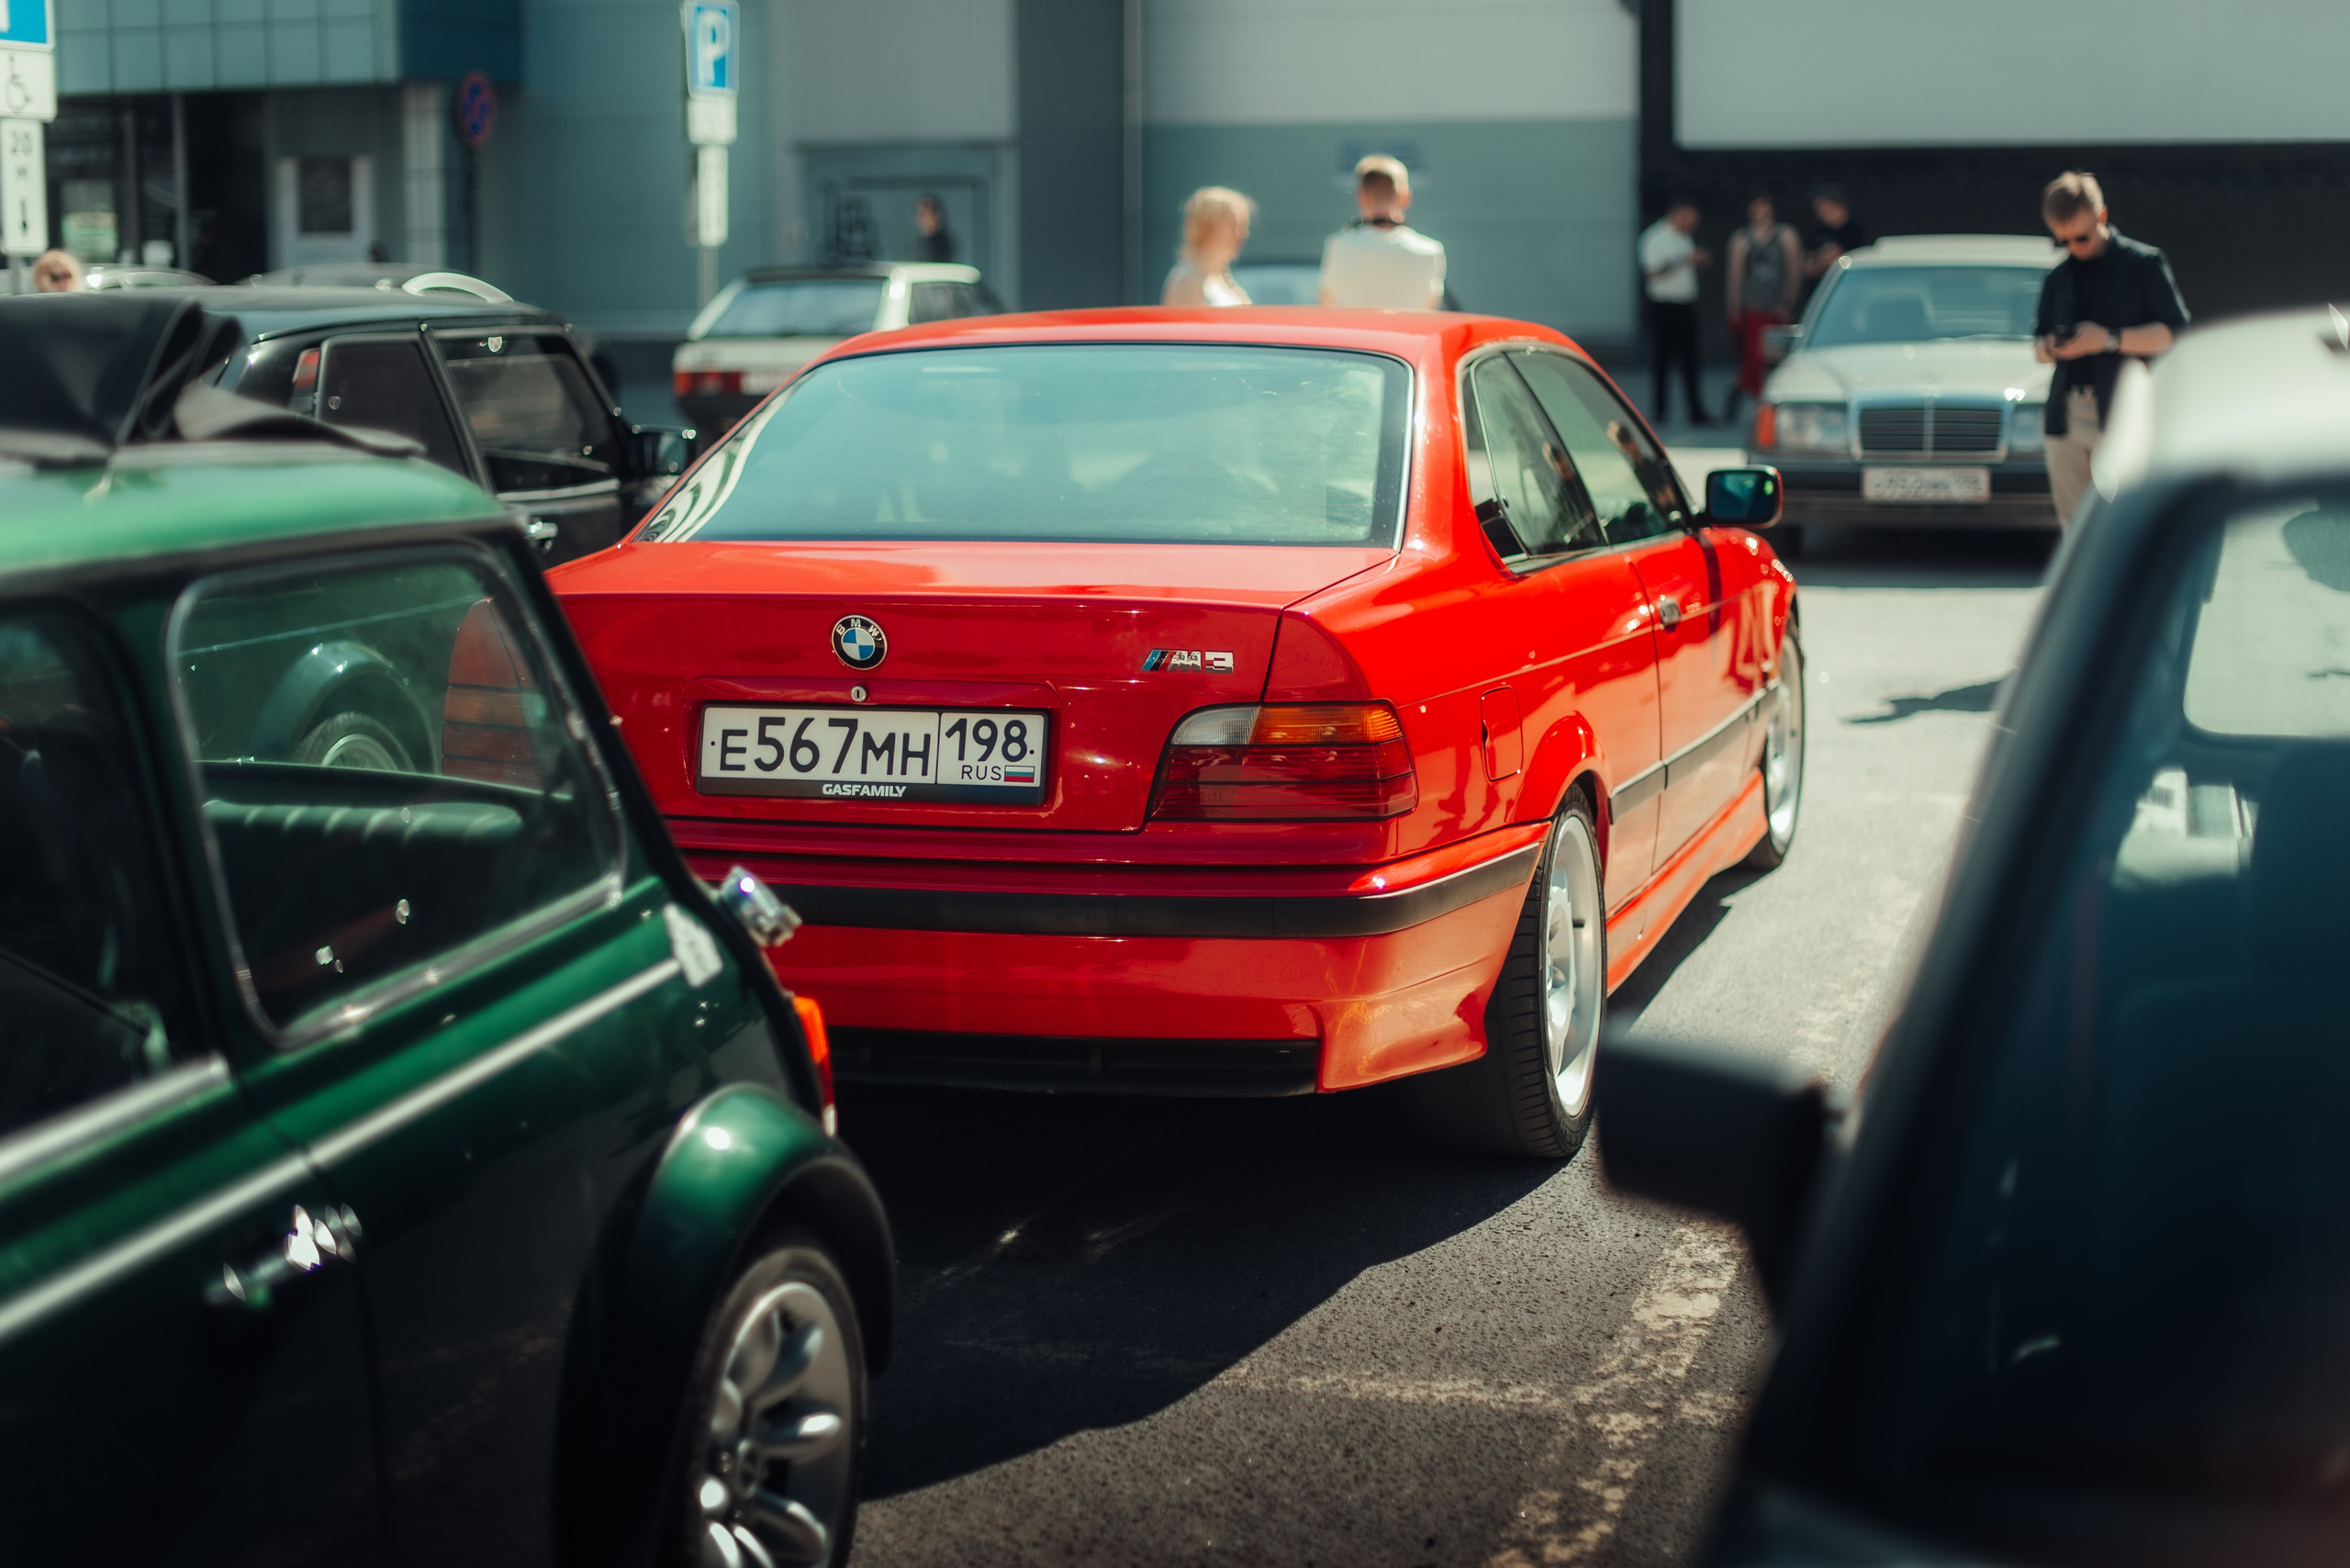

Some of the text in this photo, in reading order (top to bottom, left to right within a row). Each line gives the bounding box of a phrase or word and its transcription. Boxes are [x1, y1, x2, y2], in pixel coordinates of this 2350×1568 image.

[698, 8, 732, 87] P
[835, 618, 880, 637] BMW
[1167, 650, 1234, 674] M3
[720, 716, 1028, 777] E567MH 198
[960, 765, 1002, 781] RUS
[822, 783, 907, 798] GASFAMILY
